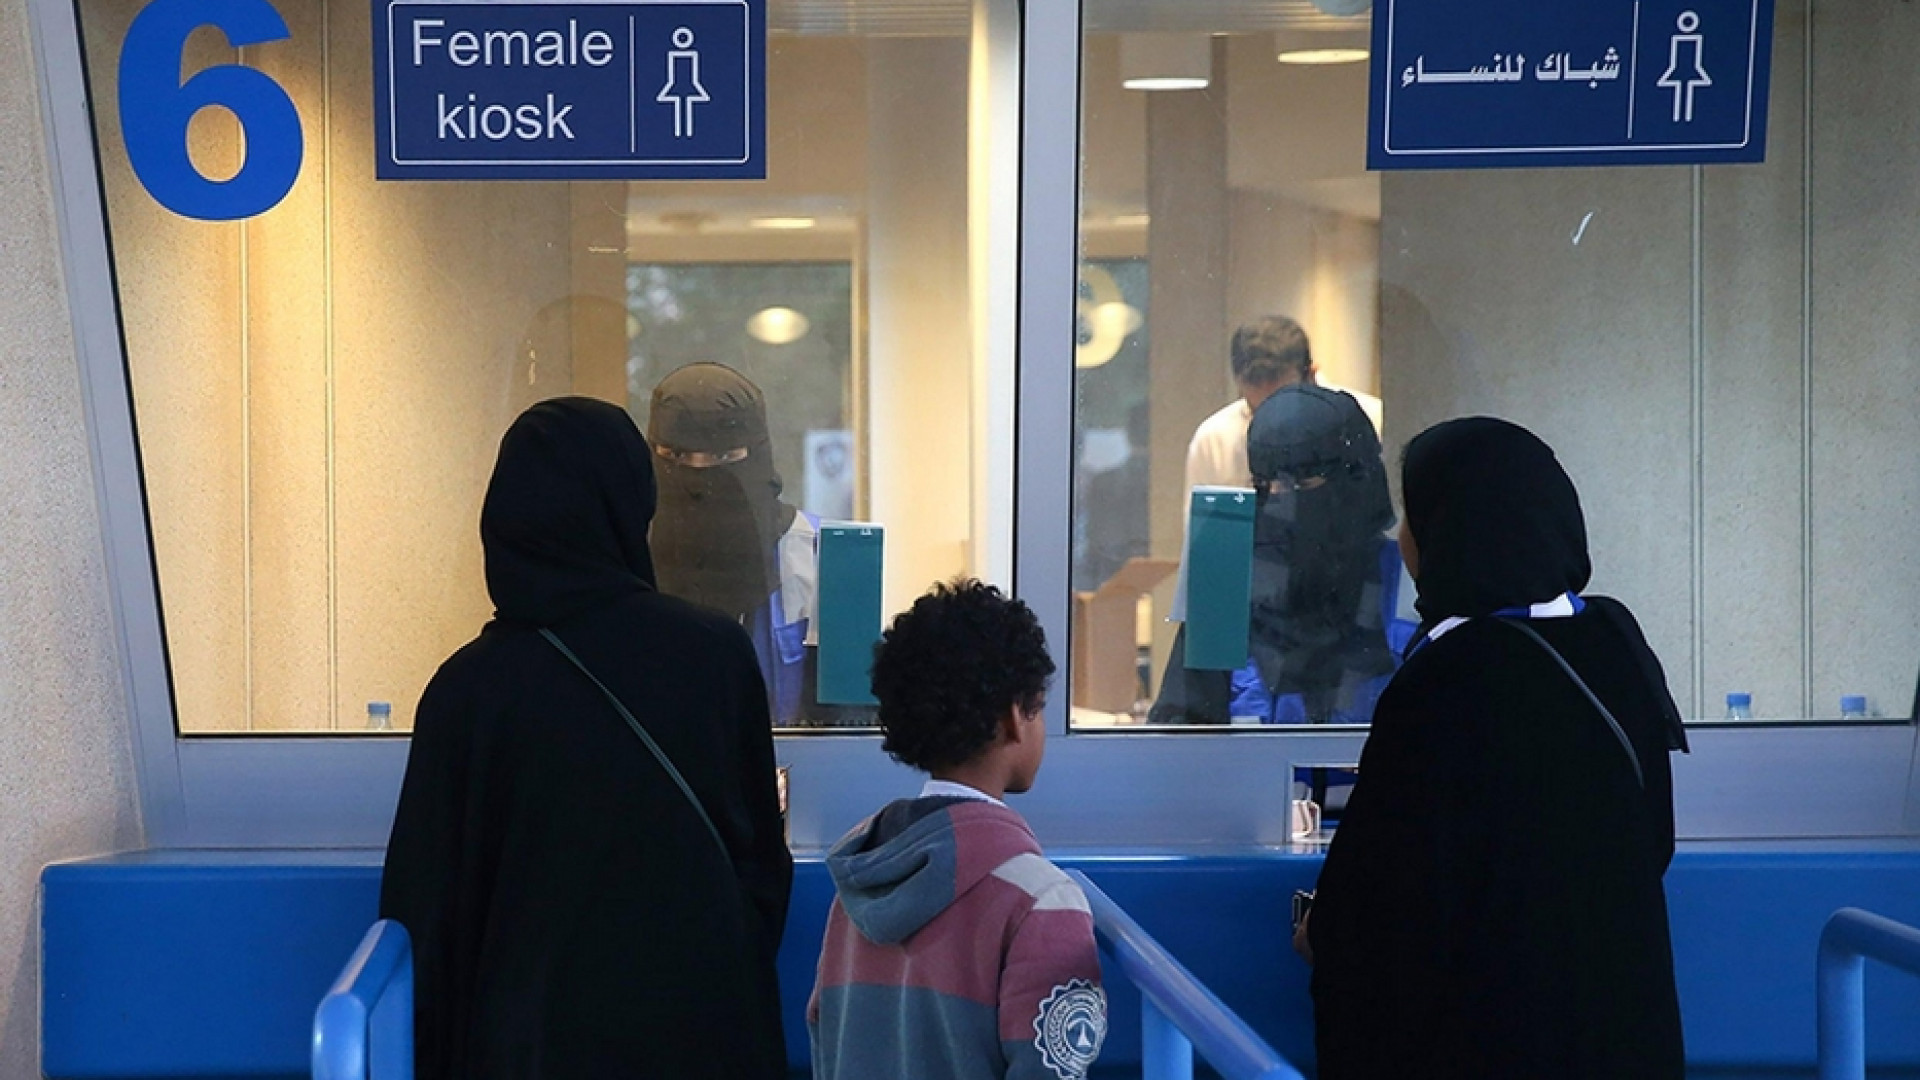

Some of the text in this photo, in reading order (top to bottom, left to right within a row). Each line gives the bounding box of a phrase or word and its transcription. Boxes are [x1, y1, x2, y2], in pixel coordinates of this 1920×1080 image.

[412, 19, 614, 67] Female
[1535, 47, 1621, 89] شباك
[118, 0, 303, 221] 6
[436, 93, 576, 139] kiosk
